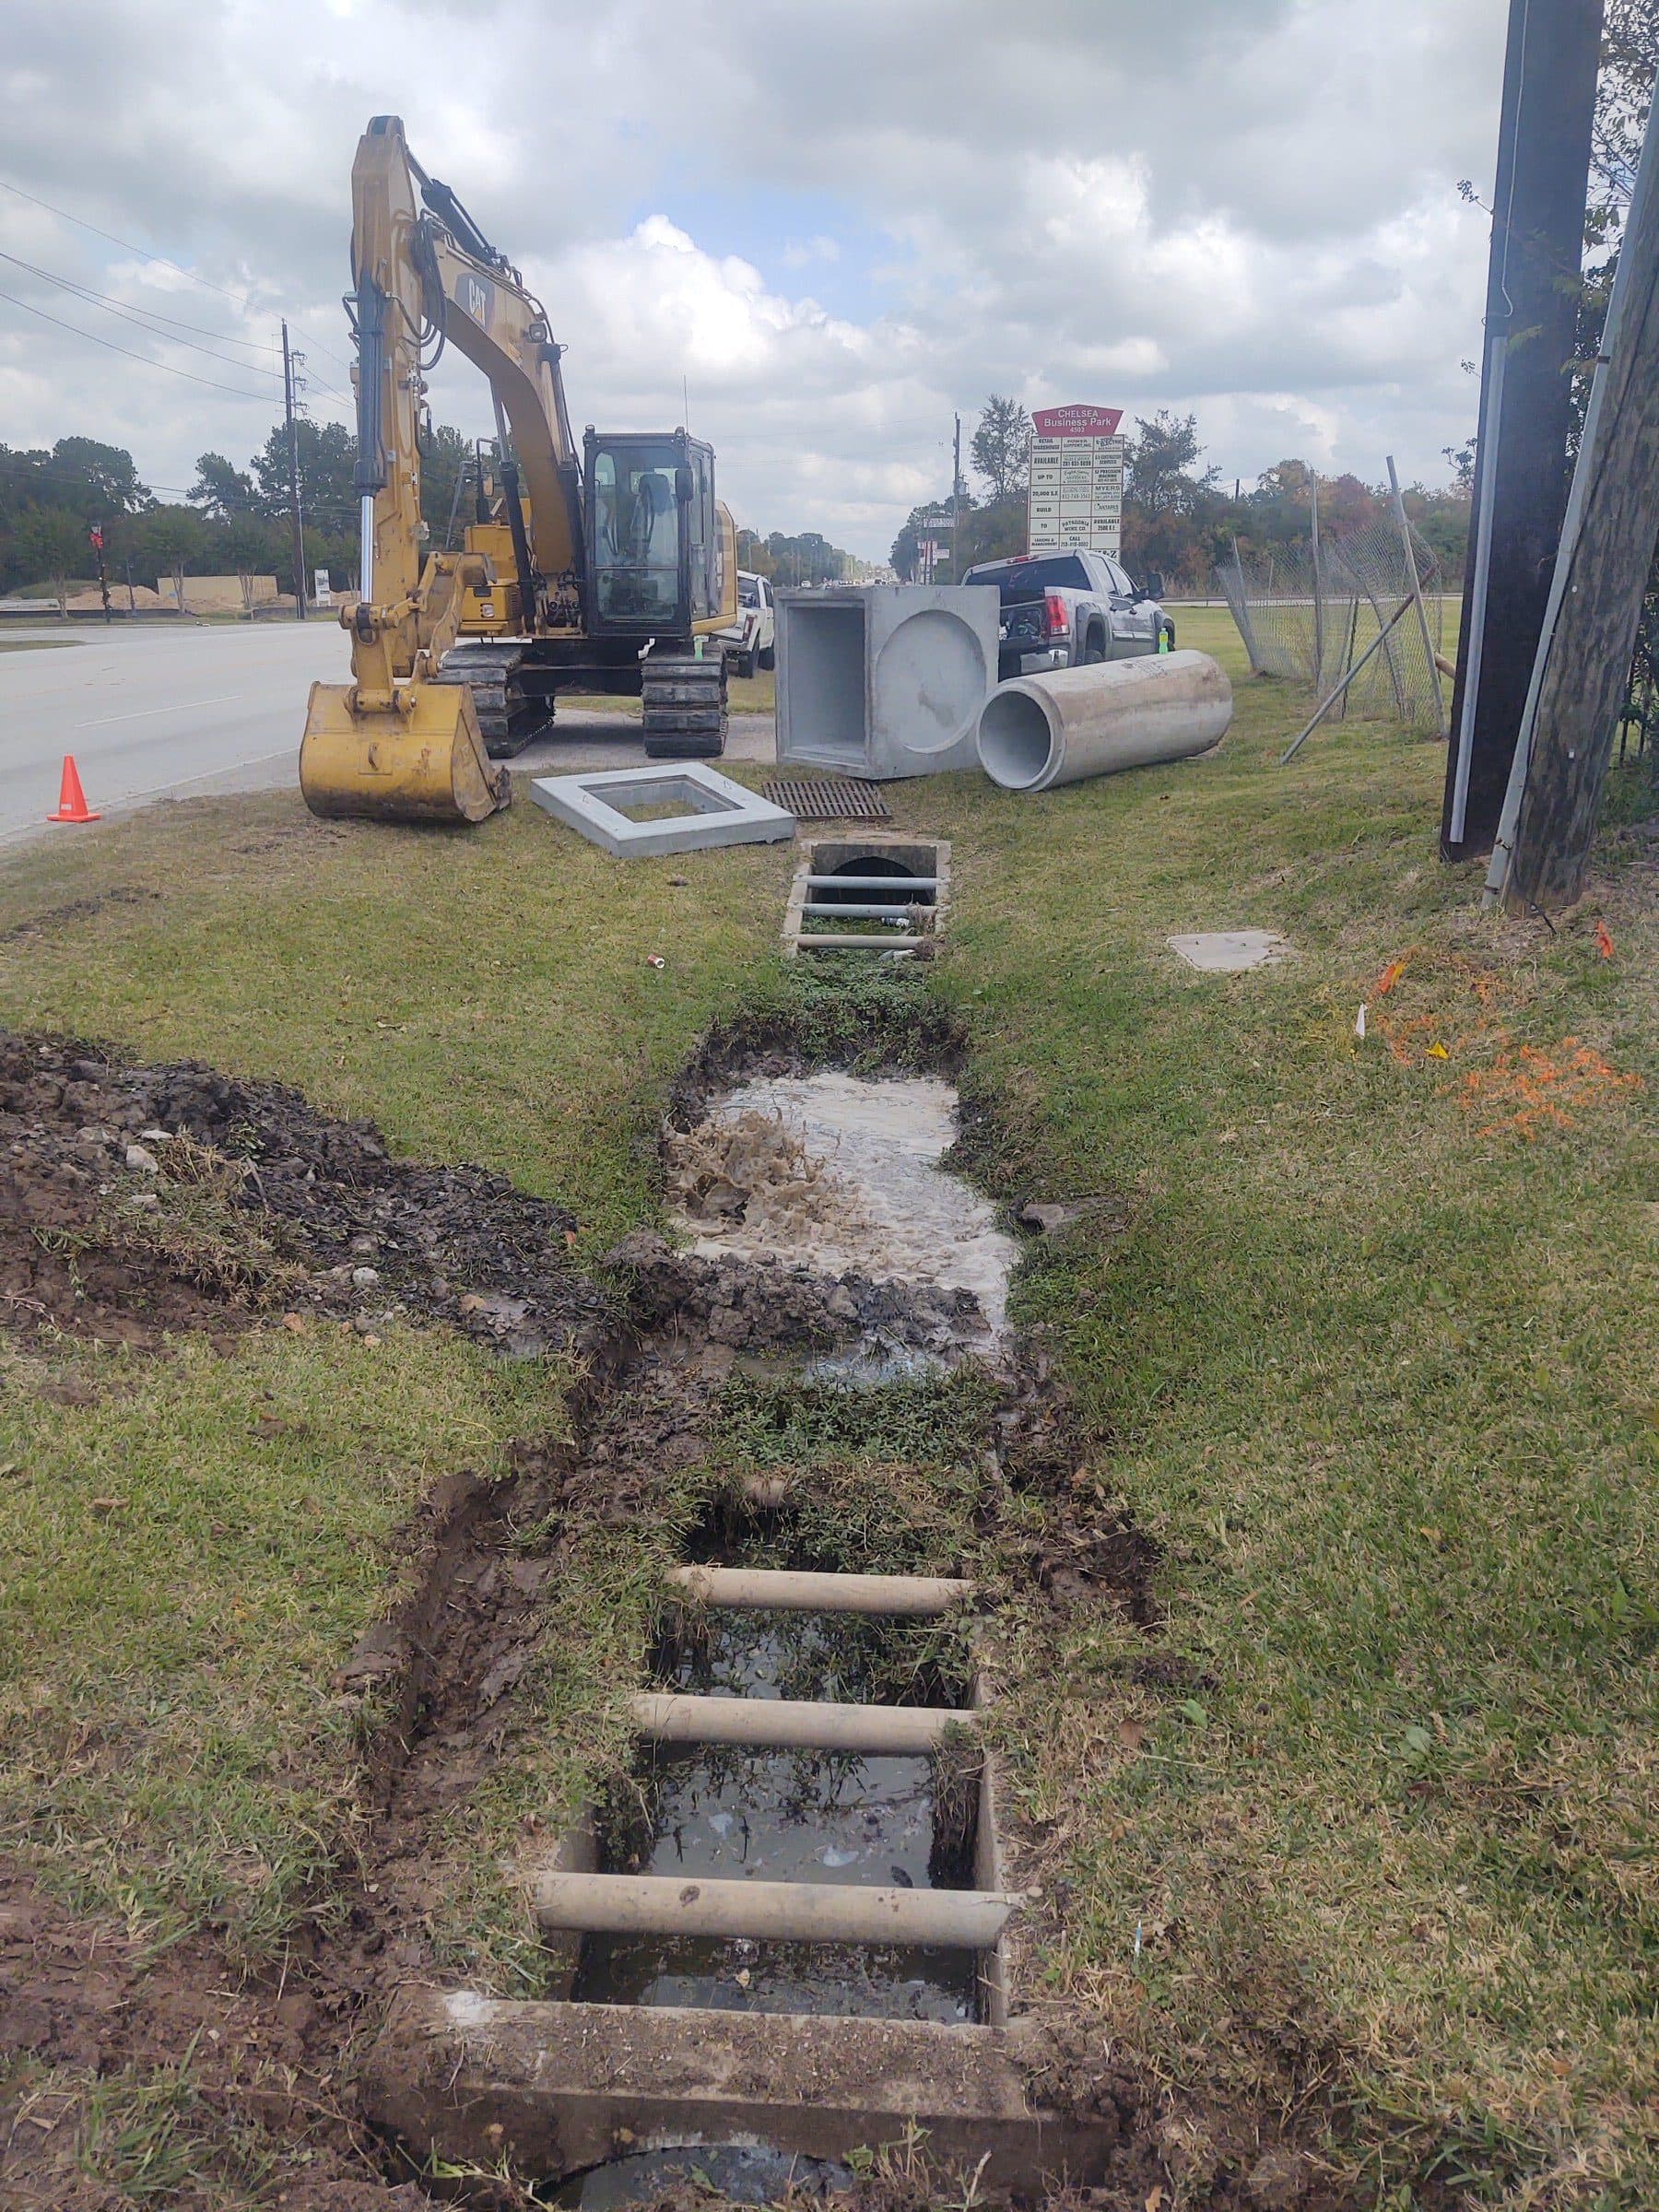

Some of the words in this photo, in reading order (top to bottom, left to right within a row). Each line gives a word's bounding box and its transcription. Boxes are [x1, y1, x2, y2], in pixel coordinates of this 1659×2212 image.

[468, 277, 487, 328] CAT
[1058, 409, 1099, 418] CHELSEA
[1044, 418, 1088, 427] Business
[1090, 418, 1112, 426] Park
